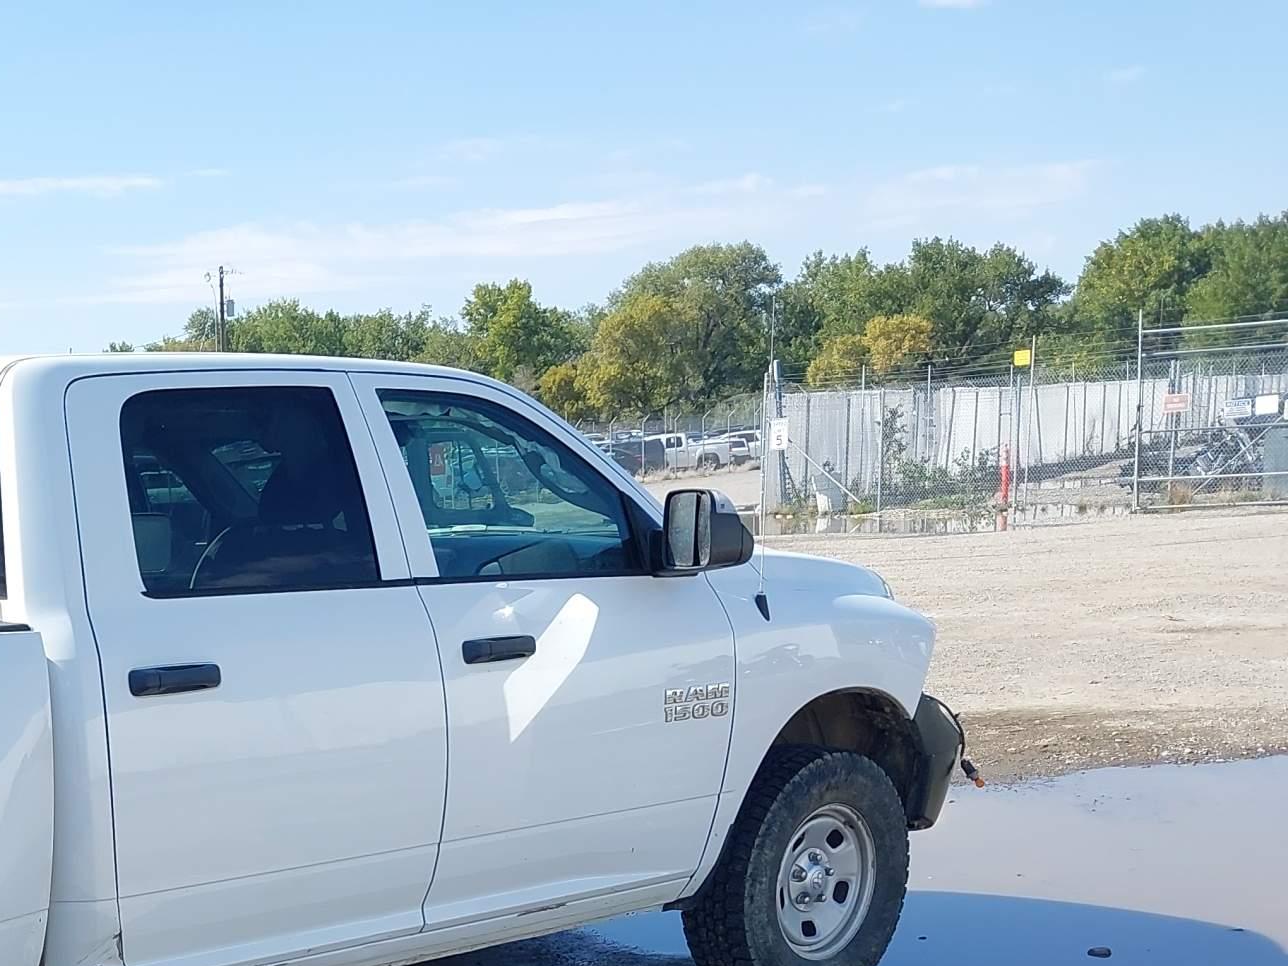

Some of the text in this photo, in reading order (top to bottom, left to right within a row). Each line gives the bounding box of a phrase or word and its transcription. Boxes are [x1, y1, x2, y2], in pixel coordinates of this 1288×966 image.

[775, 434, 783, 446] 5
[664, 682, 730, 705] RAM
[664, 700, 729, 723] 1500
